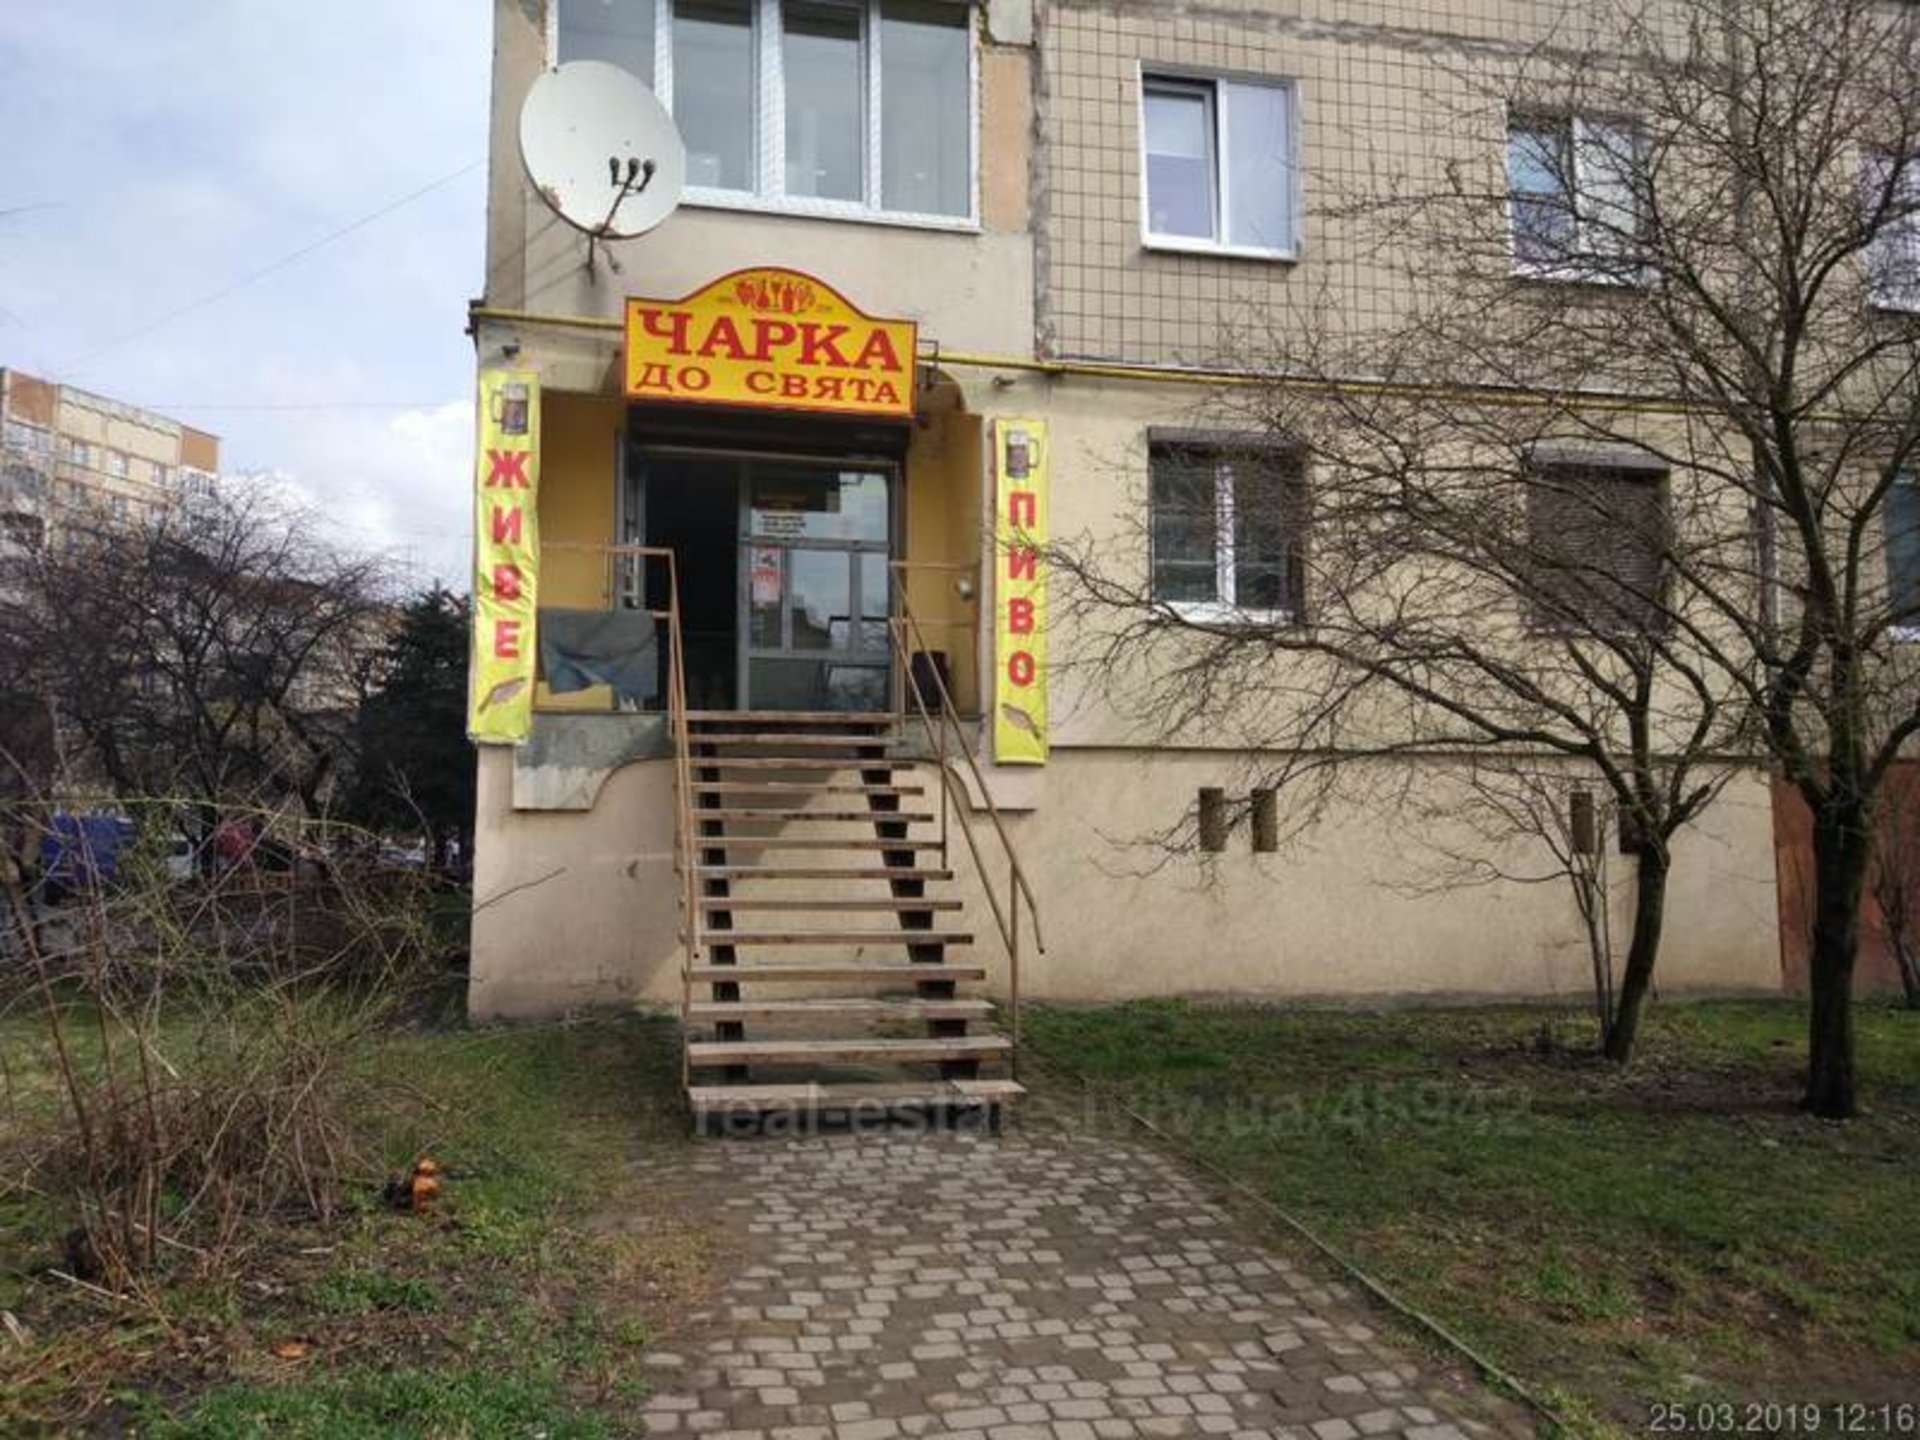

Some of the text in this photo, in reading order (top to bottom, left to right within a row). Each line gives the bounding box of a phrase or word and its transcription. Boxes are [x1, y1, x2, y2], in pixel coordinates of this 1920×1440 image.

[634, 361, 901, 404] ДО СВЯТА
[637, 308, 902, 372] ЧАРКА
[485, 447, 531, 658] ЖИВЕ
[1008, 492, 1036, 687] ПИВО
